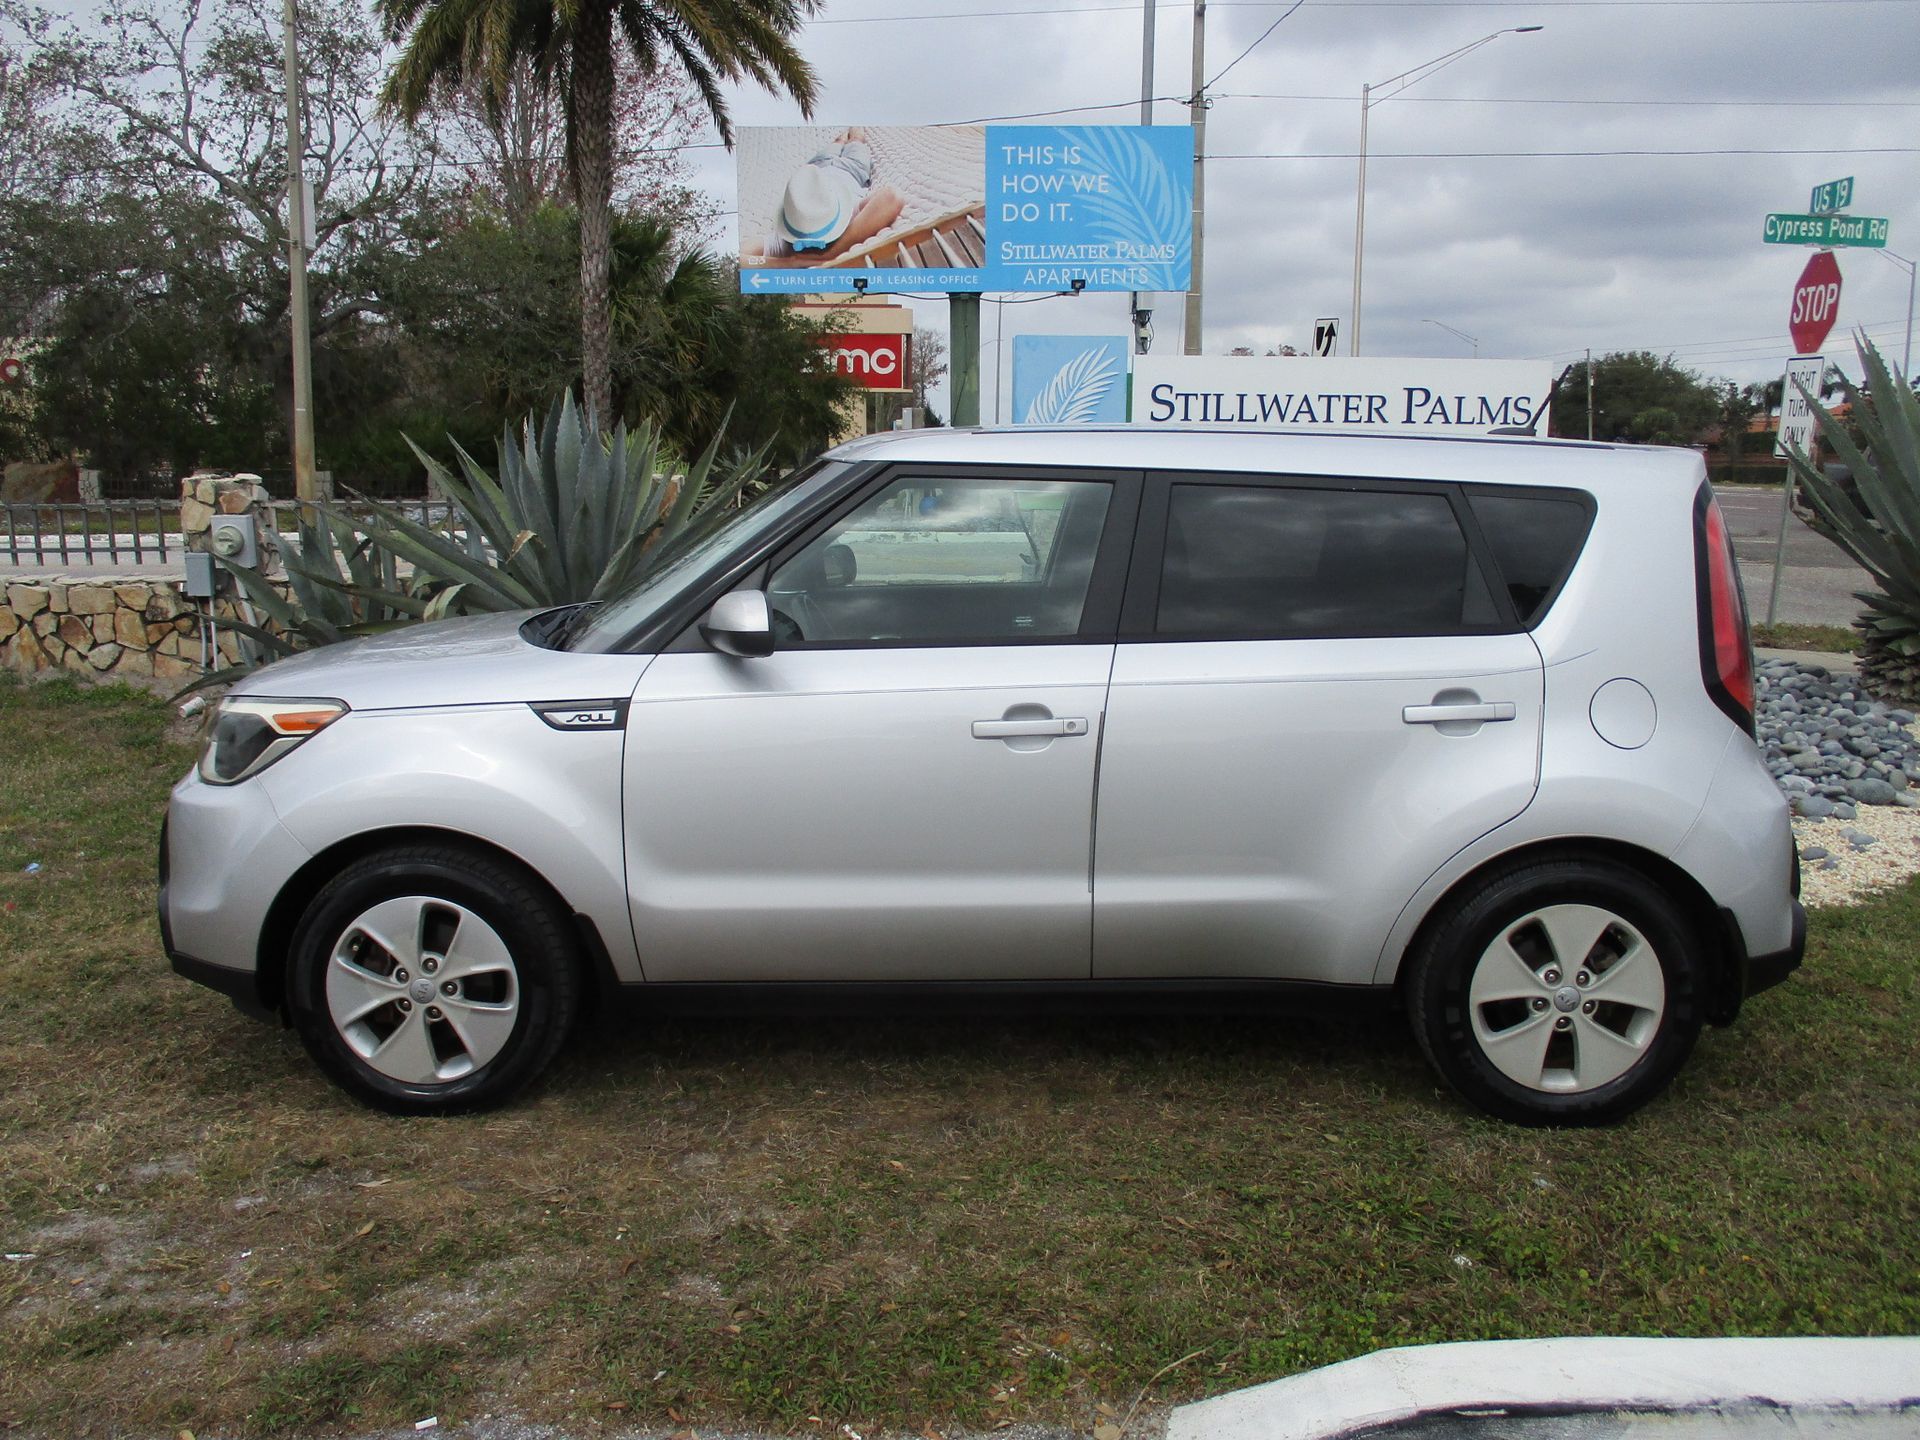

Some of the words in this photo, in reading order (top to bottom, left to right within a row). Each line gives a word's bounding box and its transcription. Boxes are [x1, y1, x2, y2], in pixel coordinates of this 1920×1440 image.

[1002, 146, 1054, 165] THIS
[1063, 146, 1081, 165] IS
[1002, 174, 1065, 194] HOW
[1071, 174, 1110, 193] WE
[1813, 185, 1830, 213] US
[1835, 180, 1849, 207] 19
[1002, 203, 1040, 222] DO
[1049, 203, 1074, 222] IT.
[1765, 215, 1823, 239] Cypress
[1829, 217, 1863, 239] Pond
[1868, 219, 1886, 240] Rd
[1001, 241, 1107, 260] STILLWATER
[1115, 240, 1176, 259] PALMS
[774, 276, 806, 286] TURN
[810, 276, 835, 286] LEFT
[839, 275, 854, 285] TO
[859, 275, 883, 285] UR
[888, 275, 935, 285] LEASING
[939, 275, 979, 285] OFFICE
[1023, 268, 1149, 285] APARTMENTS
[1792, 282, 1839, 325] STOP
[1789, 371, 1817, 389] RIGHT
[1149, 383, 1389, 424] STILLWATER
[1401, 386, 1533, 427] PALMS
[1783, 426, 1807, 445] ONLY
